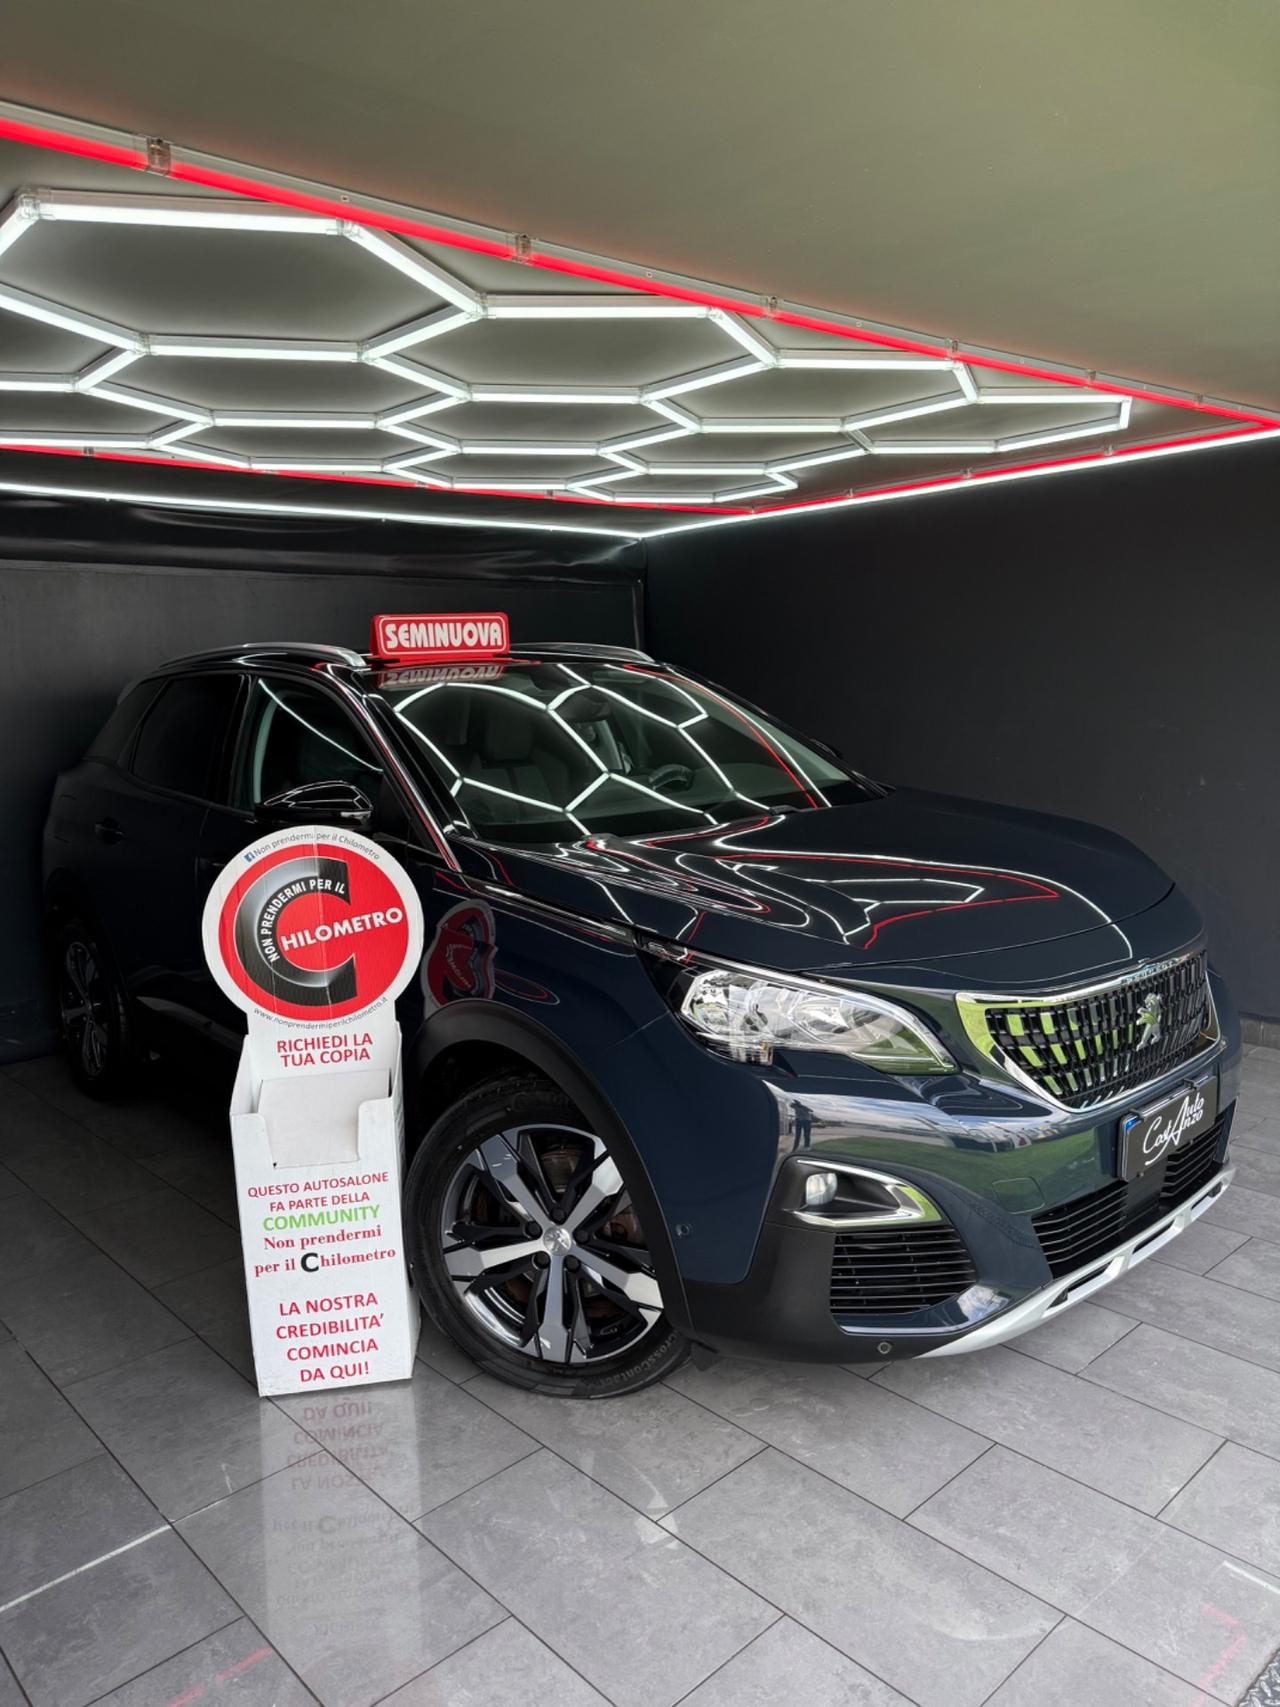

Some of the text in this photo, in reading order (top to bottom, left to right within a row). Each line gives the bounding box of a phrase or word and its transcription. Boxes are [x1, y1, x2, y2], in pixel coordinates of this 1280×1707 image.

[385, 622, 502, 649] SEMINUOVA
[339, 835, 380, 860] Chilometro
[260, 878, 346, 963] NON PRENDERMI PER IL
[253, 997, 388, 1030] www.nonprendermiperilchilometro.it
[276, 1032, 373, 1054] RICHIEDI LA
[280, 1047, 371, 1068] TUA COPIA
[247, 1171, 389, 1198] QUESTO AUTOSALONE
[269, 1191, 370, 1212] FA PARTE DELLA
[262, 1204, 380, 1231] COMMUNITY
[264, 1224, 382, 1250] Non prendermi
[254, 1248, 396, 1278] per il Chilometro
[279, 1291, 378, 1317] LA NOSTRA
[286, 1338, 379, 1361] COMINCIA
[300, 1360, 369, 1382] DA QUI!
